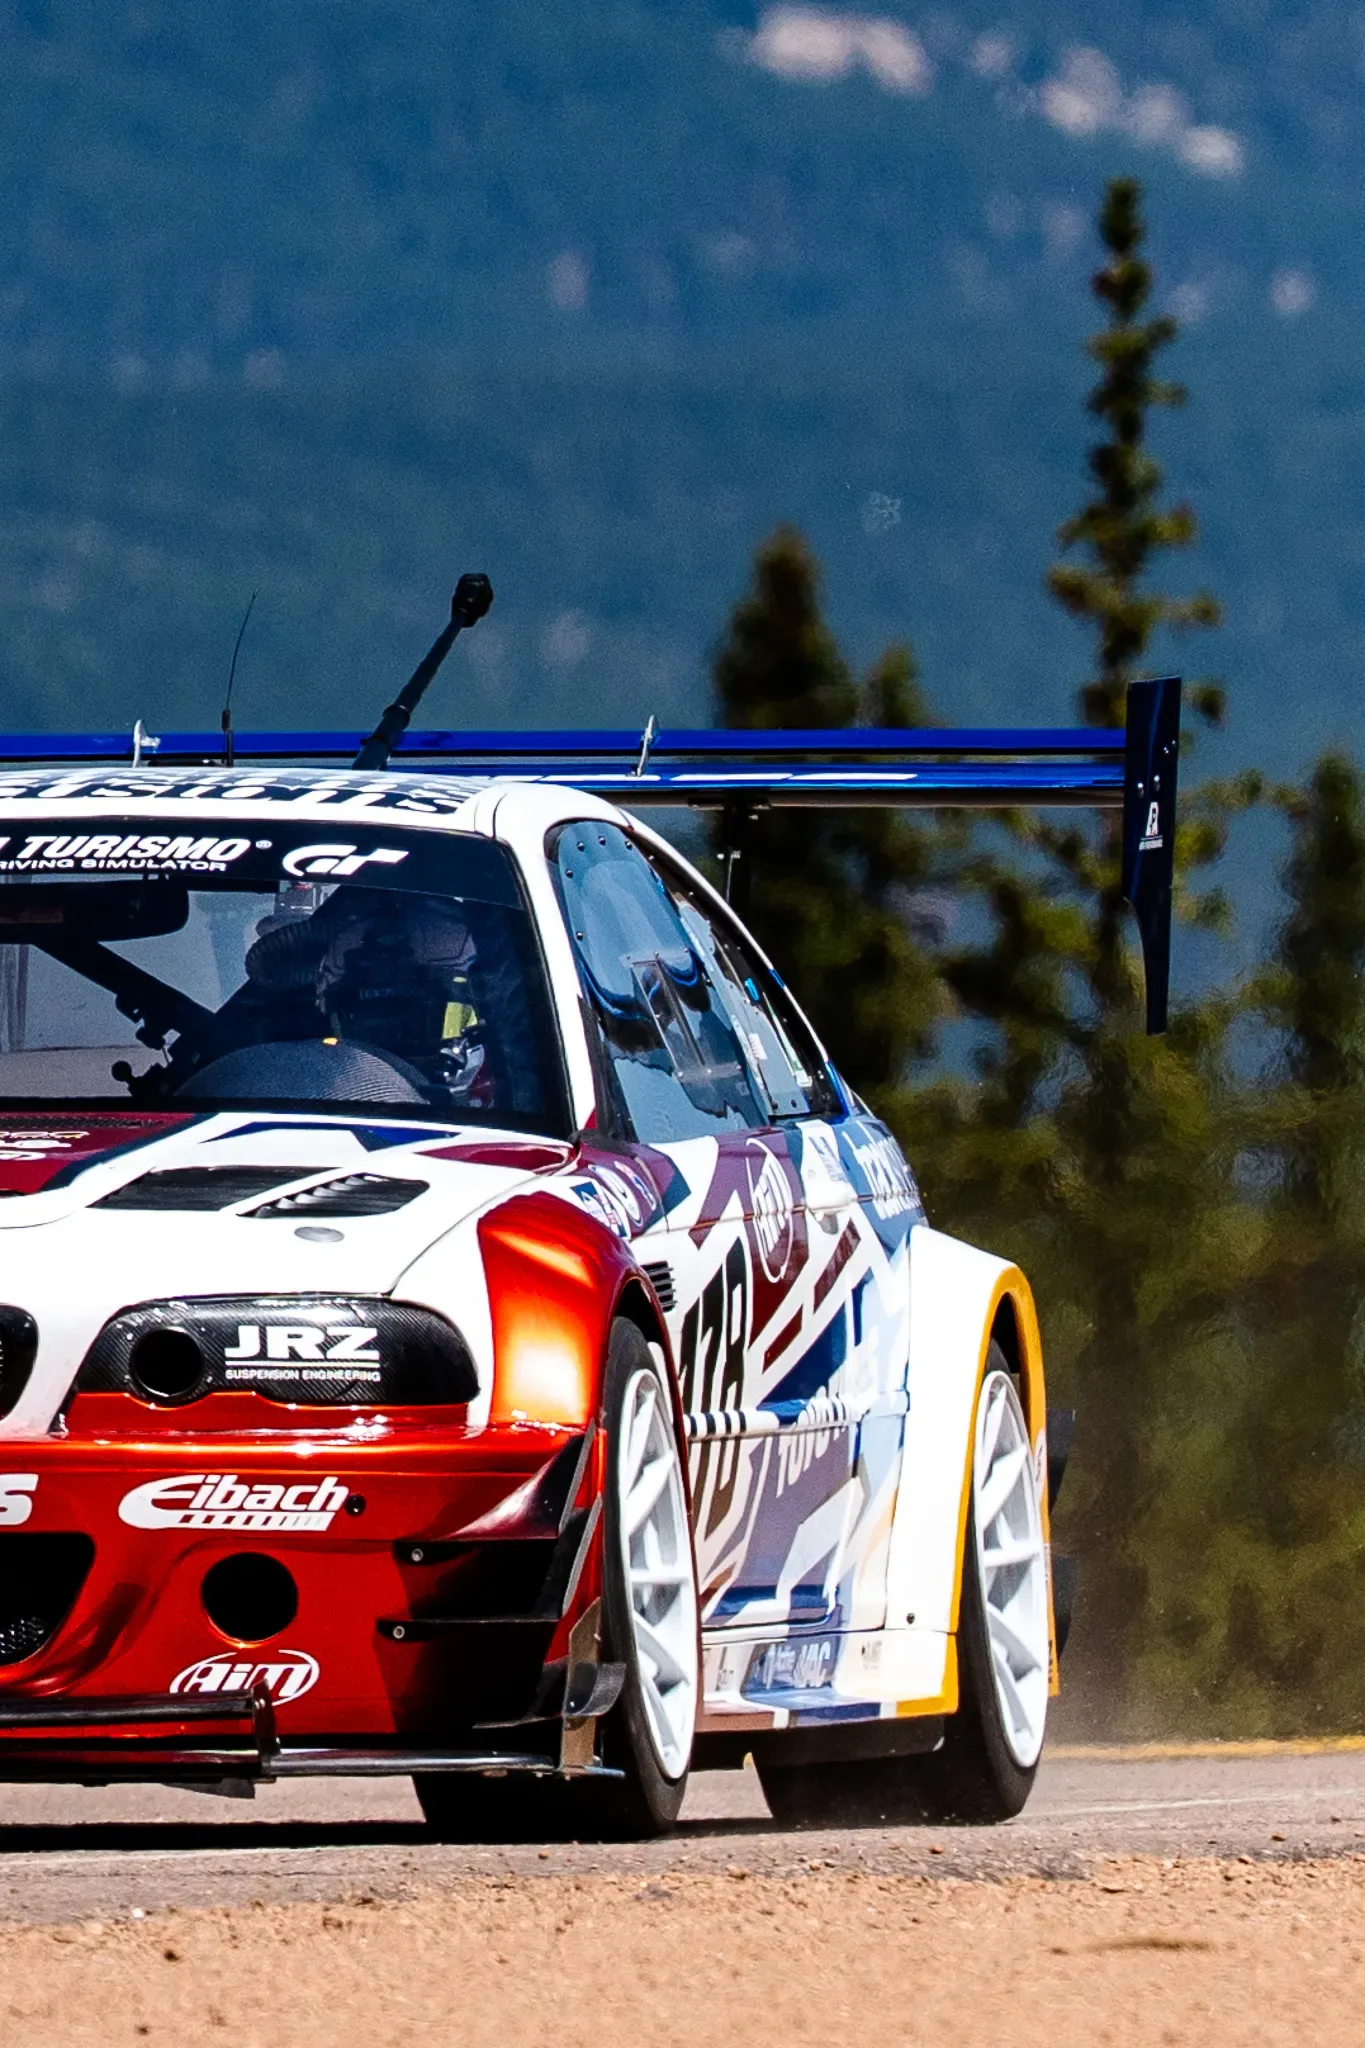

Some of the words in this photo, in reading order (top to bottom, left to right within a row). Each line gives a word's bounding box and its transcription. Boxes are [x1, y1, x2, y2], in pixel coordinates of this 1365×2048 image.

[16, 835, 252, 862] TURISMO
[80, 858, 227, 872] SIMULATOR
[224, 1324, 380, 1360] JRZ
[224, 1368, 300, 1381] SUSPENSION
[302, 1369, 381, 1383] ENGINEERING
[118, 1474, 349, 1531] Eibach
